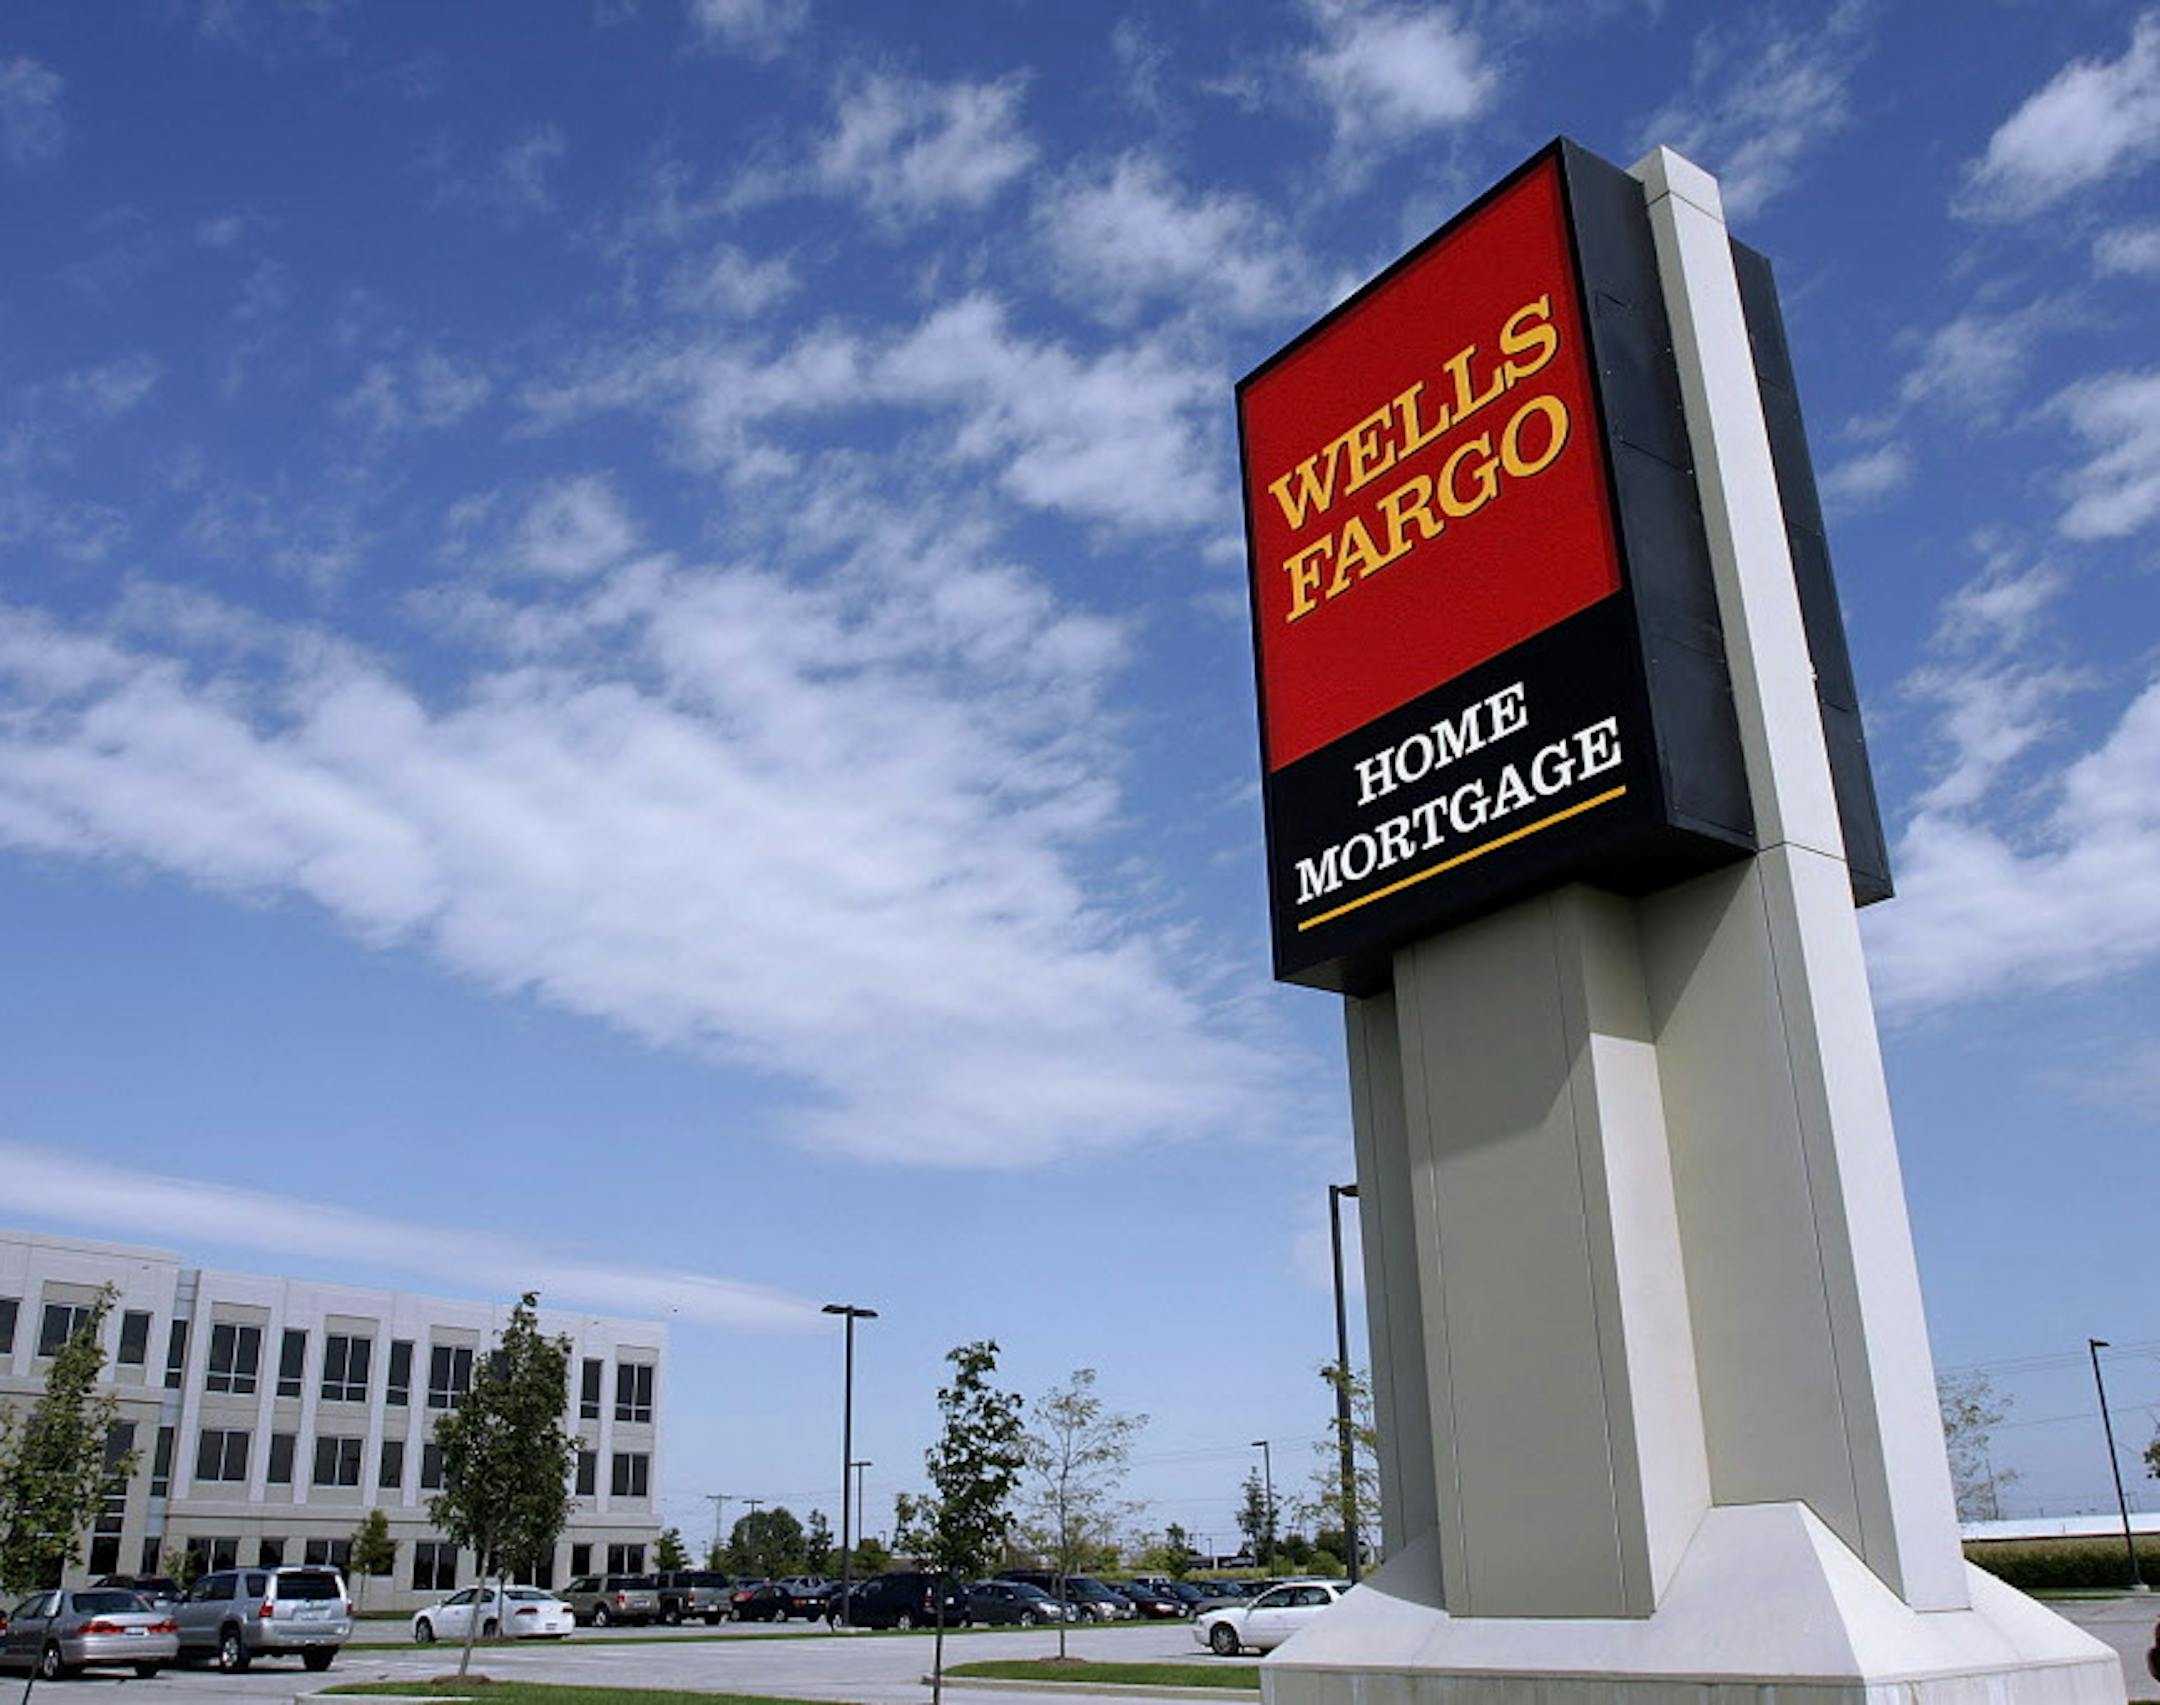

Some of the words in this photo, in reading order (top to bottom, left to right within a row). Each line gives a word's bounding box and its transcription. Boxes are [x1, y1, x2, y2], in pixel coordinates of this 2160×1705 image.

[1268, 294, 1558, 531] WELLS
[1282, 394, 1570, 623] FARGO
[1295, 716, 1623, 905] MORTGAGE
[1354, 681, 1529, 806] HOME
